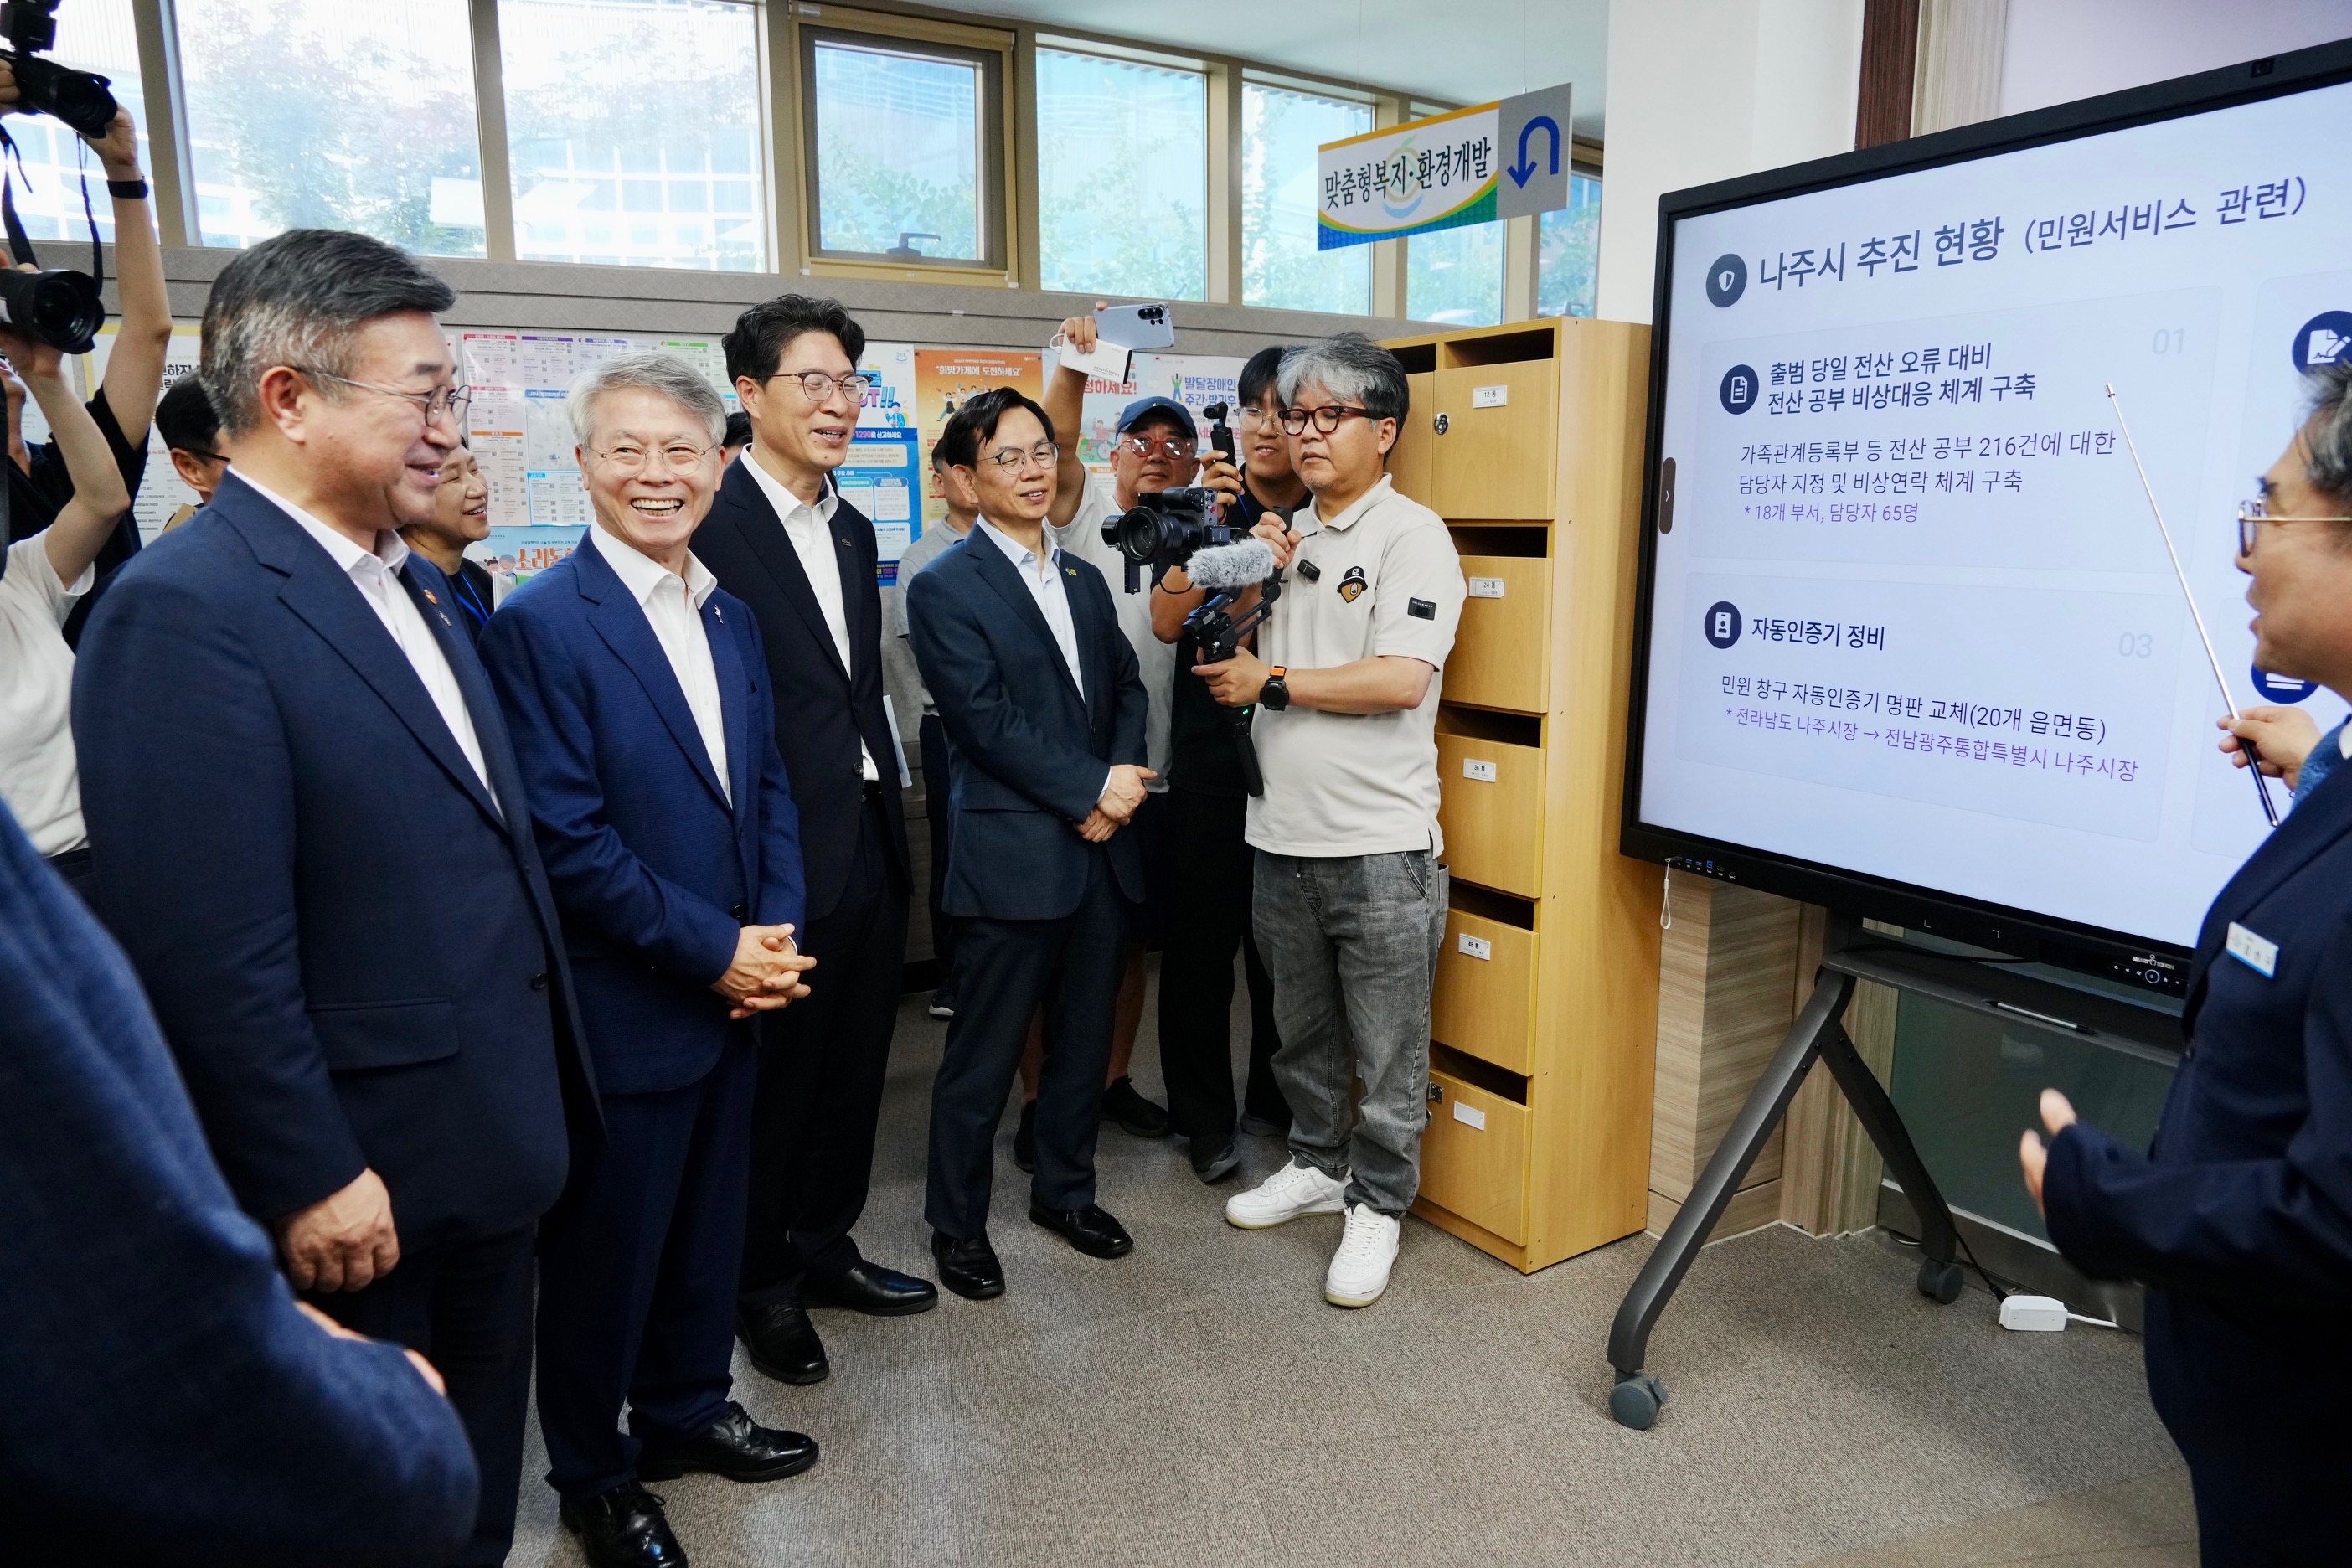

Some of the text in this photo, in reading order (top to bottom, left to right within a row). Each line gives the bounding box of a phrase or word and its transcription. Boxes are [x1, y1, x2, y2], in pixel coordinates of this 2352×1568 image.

[1325, 137, 1492, 210] 맞춤형복지·환경개발
[1760, 175, 2306, 291] 나주시 추진 현황 (민원서비스 관련)
[2152, 327, 2185, 356] 01
[1769, 342, 1992, 386] 출범 당일 전산 오류 대비
[1184, 376, 1237, 392] 발달장애인
[1767, 372, 2037, 415] 전산 공부 비상대응 체계 구축
[1741, 429, 2117, 465] 가족관계등록부 등 전산 공부 216건에 대한
[1739, 468, 2023, 495] 담당자 지정 및 비상연락 체계 구축
[1755, 503, 1786, 522] 18개
[1790, 503, 1825, 524] 부서,
[1829, 503, 1877, 523] 담당자
[1882, 503, 1918, 524] 65명
[1351, 568, 1360, 576] GB
[1751, 617, 1885, 652] 자동인증기 정비
[2118, 632, 2153, 659] 03
[1721, 675, 2106, 745] 민원 창구 자동인증기 명판 교체(20개 읍면동)
[1736, 708, 1792, 730] 전라남도
[1797, 715, 1859, 741] 나주시장
[1885, 728, 2047, 770] 전남광주통합특별시
[2055, 751, 2138, 782] 나주시장
